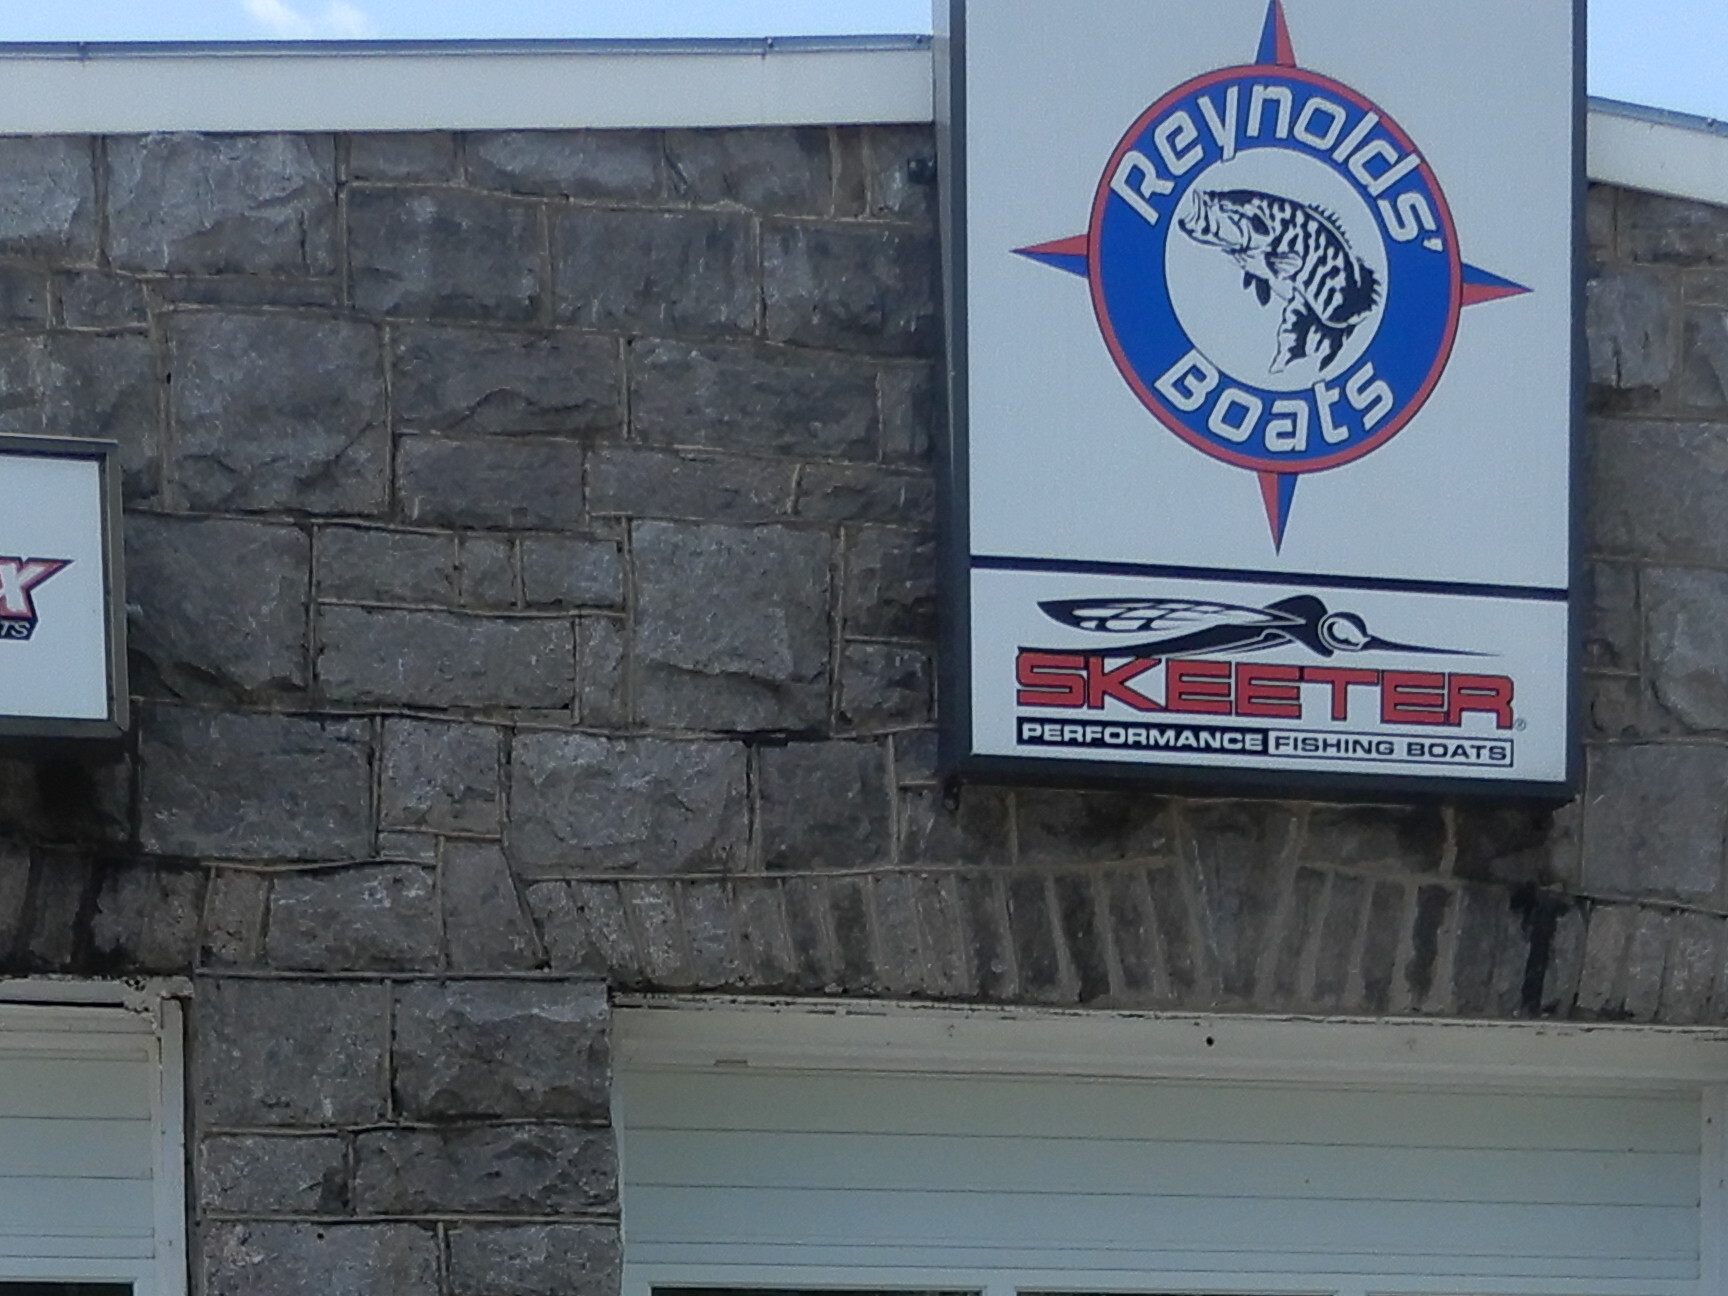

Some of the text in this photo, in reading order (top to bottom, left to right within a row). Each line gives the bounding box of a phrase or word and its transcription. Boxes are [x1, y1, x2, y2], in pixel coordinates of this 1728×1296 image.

[1154, 349, 1393, 453] Boats
[1015, 650, 1515, 730] SKEETER
[1020, 721, 1508, 763] PERFORMANCE FISHING BOATS
